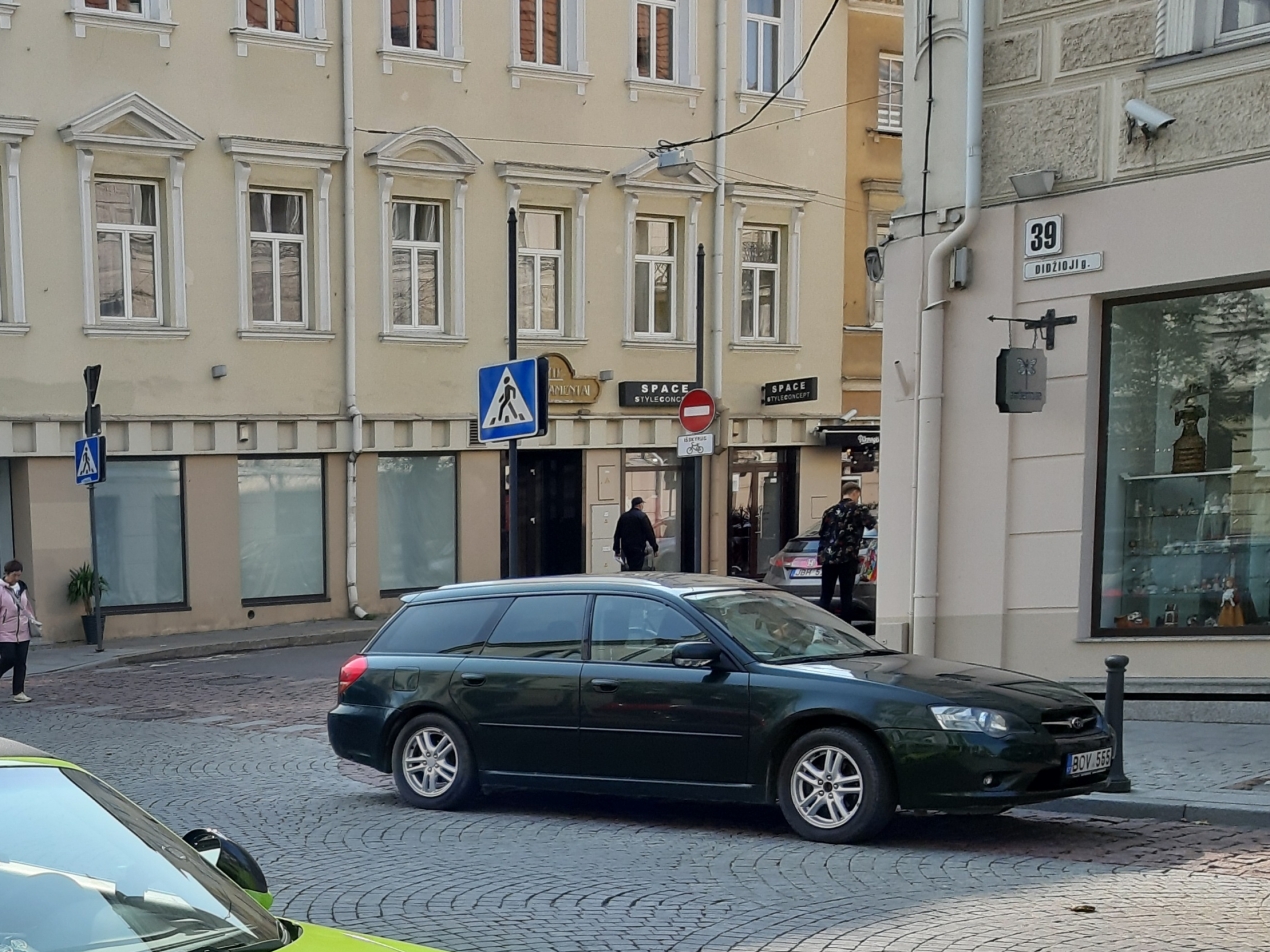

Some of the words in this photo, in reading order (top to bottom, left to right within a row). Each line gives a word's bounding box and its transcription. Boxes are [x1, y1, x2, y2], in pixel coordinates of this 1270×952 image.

[1031, 221, 1057, 251] 39
[1035, 259, 1079, 275] DIDŽIOJI
[641, 384, 689, 393] SPACE
[771, 381, 806, 393] SPACE
[767, 391, 811, 403] STYLECONCEPT
[1072, 753, 1092, 772] BOV
[1096, 749, 1111, 767] 555
